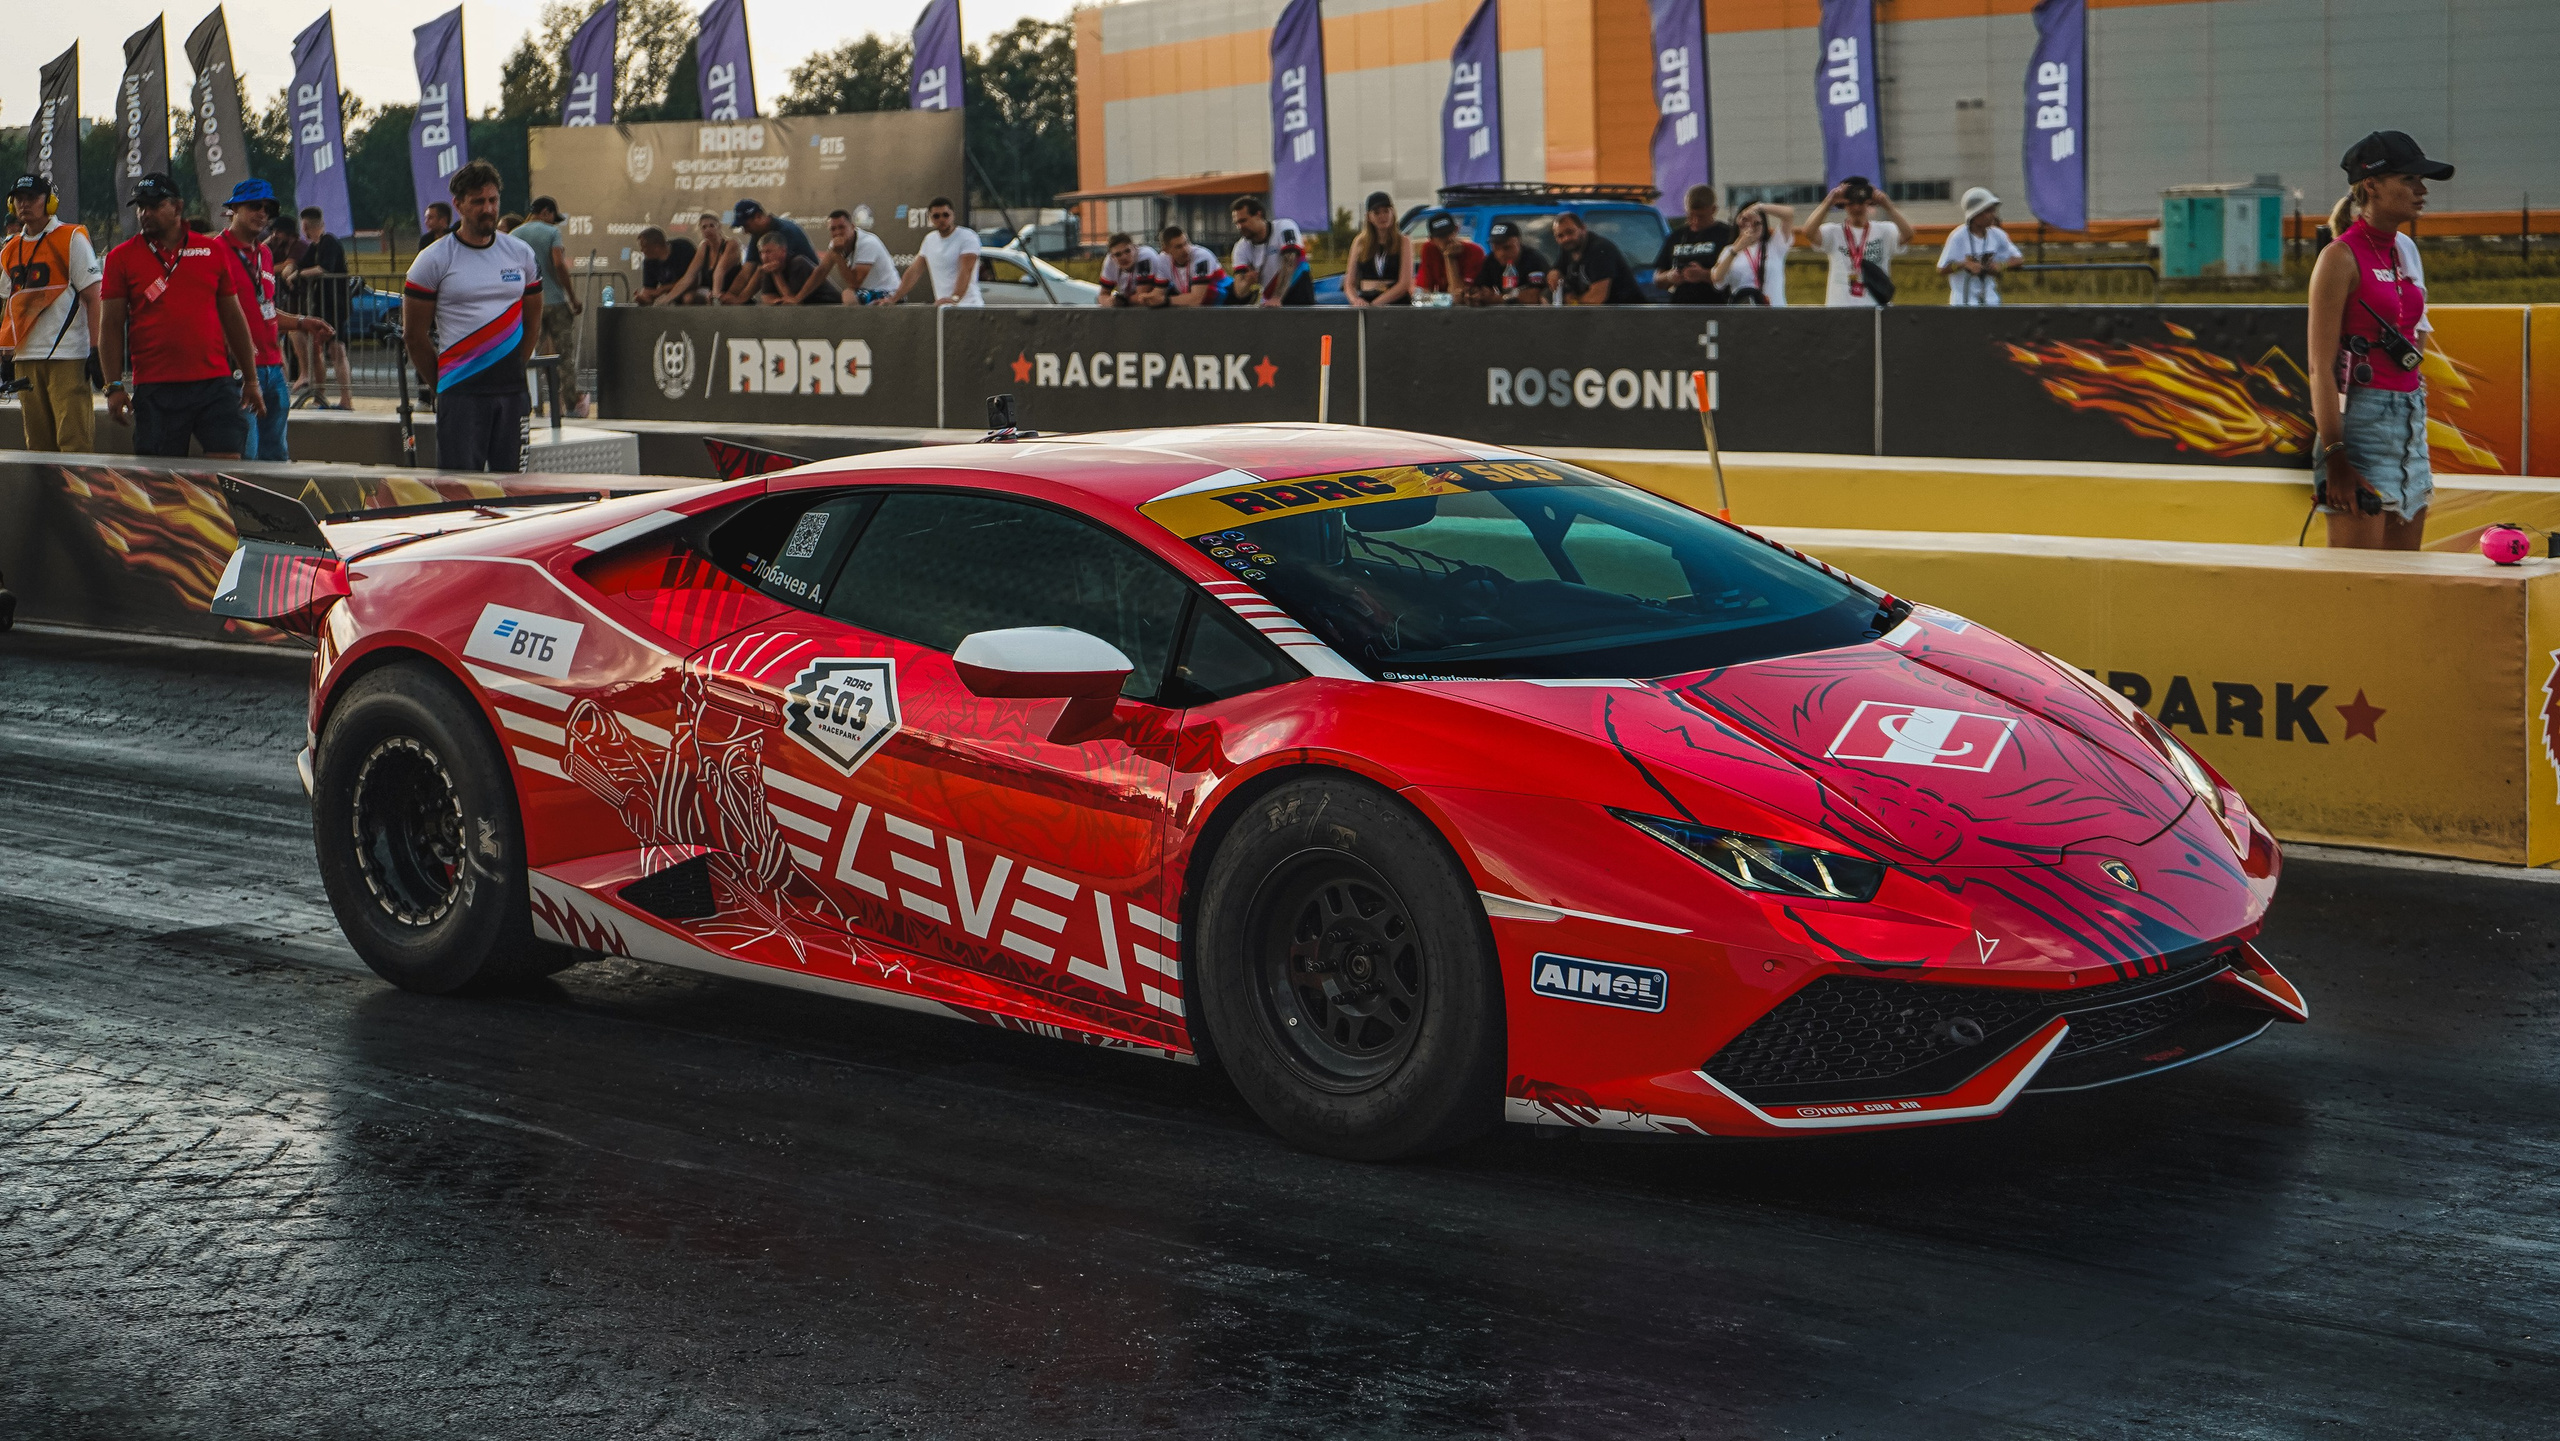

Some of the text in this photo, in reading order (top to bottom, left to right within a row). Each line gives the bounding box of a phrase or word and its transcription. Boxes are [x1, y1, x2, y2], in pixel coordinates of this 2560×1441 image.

[727, 338, 872, 396] RDRC
[1036, 352, 1253, 392] RACEPARK
[1488, 366, 1719, 410] ROSGONKI
[1459, 463, 1564, 483] 503
[1210, 474, 1396, 516] RDRC
[753, 559, 808, 596] Лобачев
[508, 627, 558, 663] ВТБ
[843, 676, 874, 691] RDRC
[813, 684, 874, 731] 503
[2088, 669, 2330, 744] PARK
[821, 724, 858, 741] RACEPARK
[1536, 963, 1659, 1004] AIMOL
